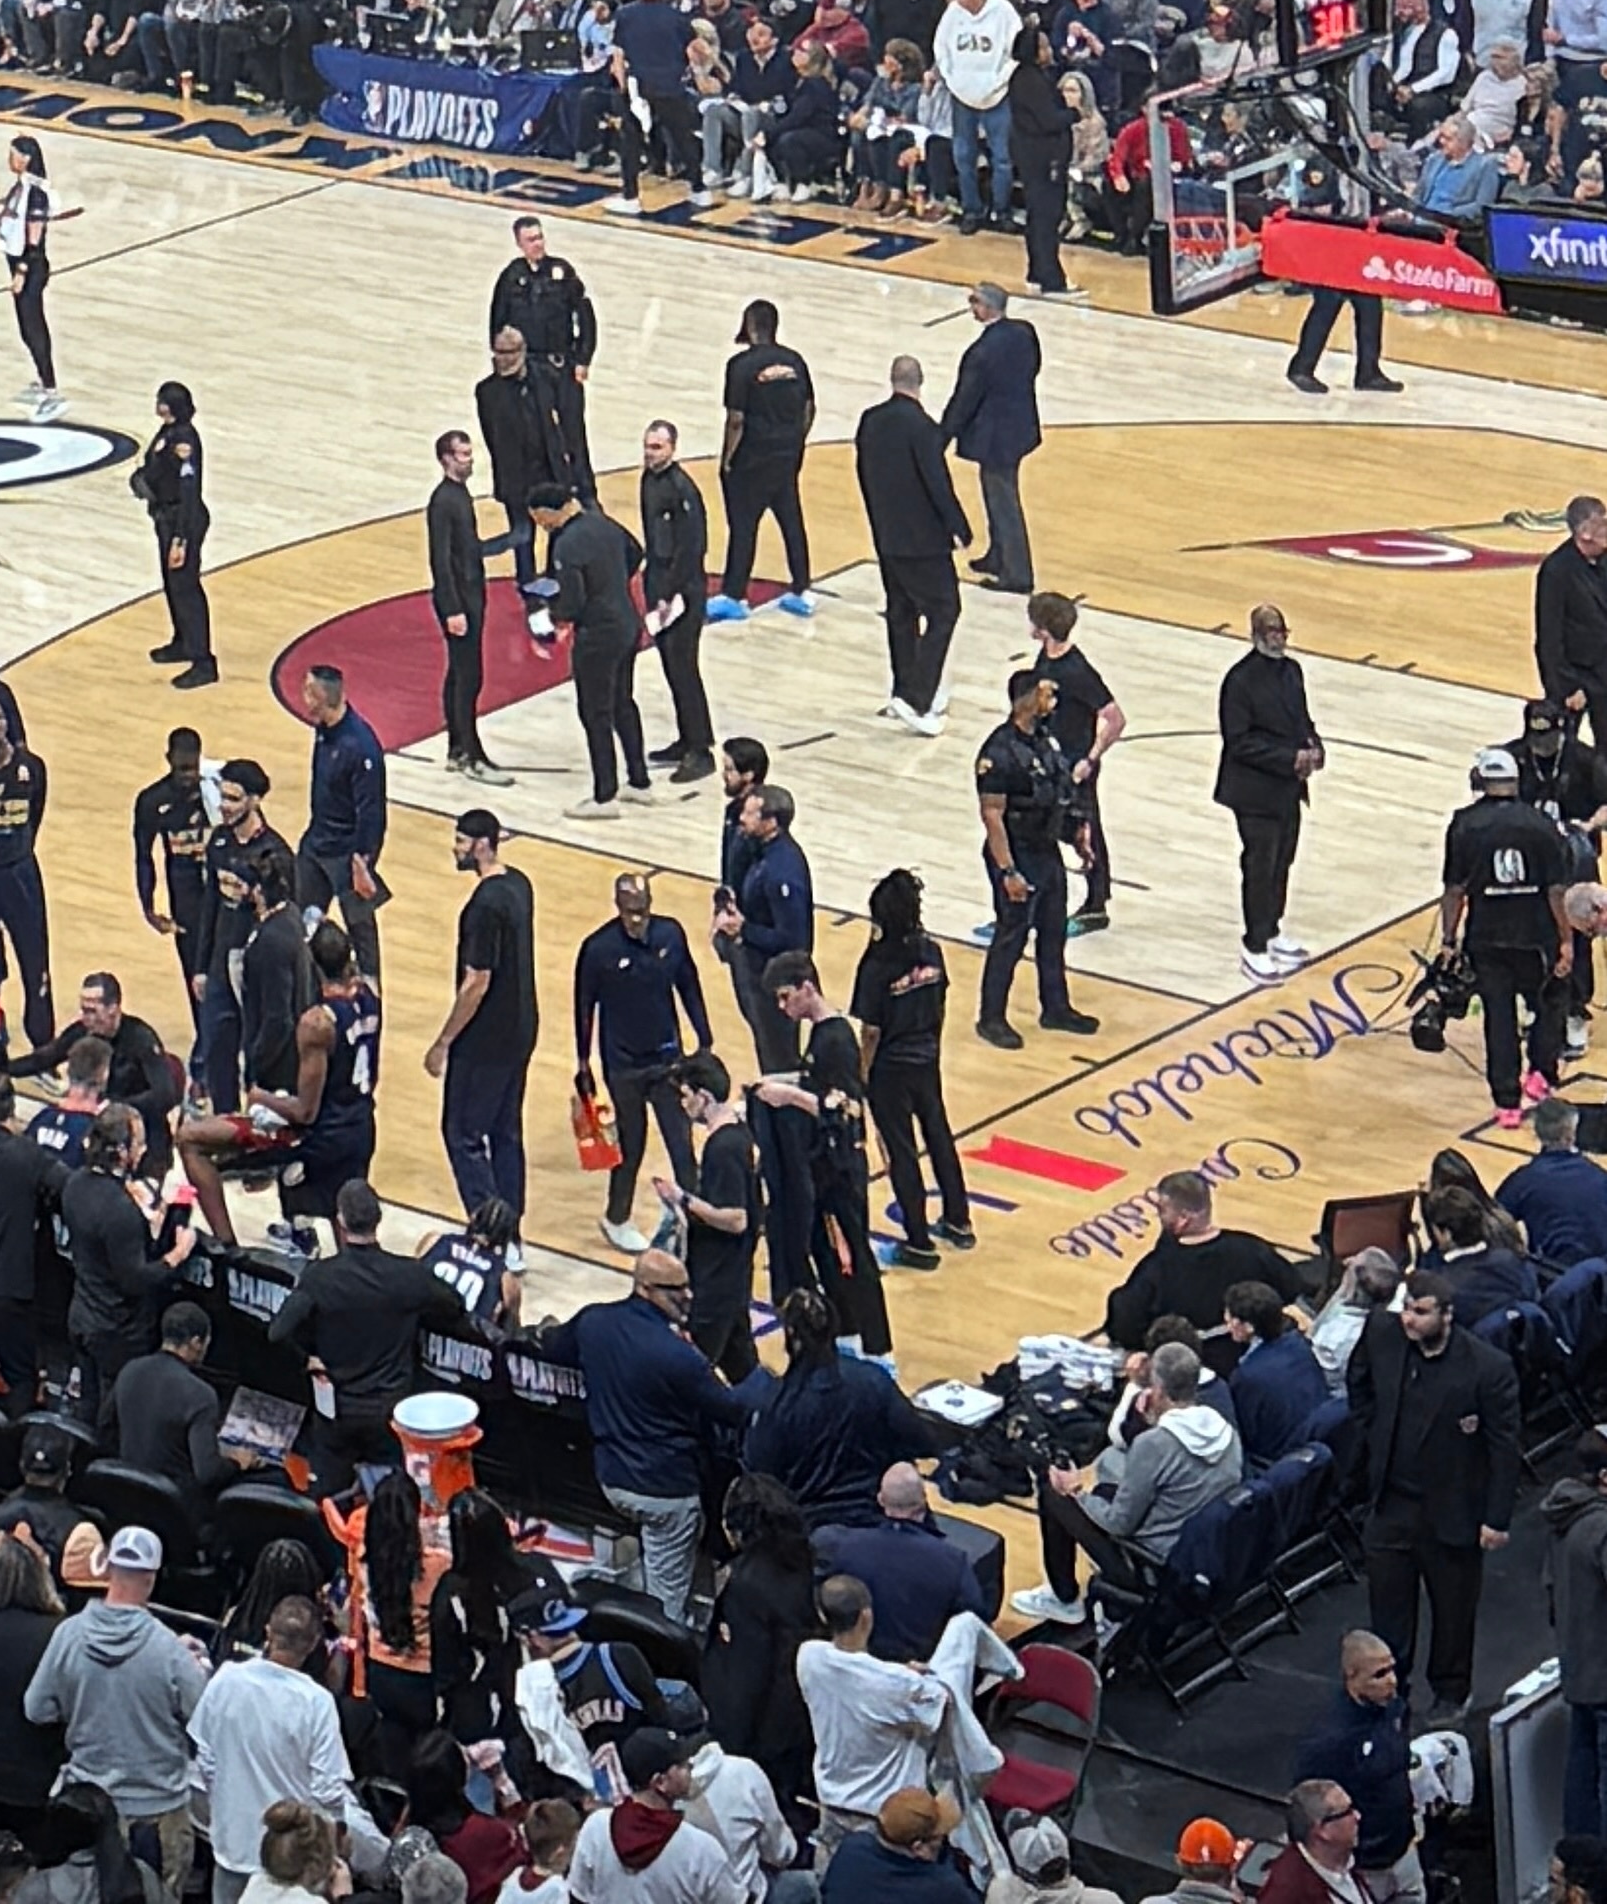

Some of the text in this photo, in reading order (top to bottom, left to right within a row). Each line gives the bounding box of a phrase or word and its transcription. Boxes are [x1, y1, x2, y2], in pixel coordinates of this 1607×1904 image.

[385, 82, 499, 149] PLAYOFFS
[1393, 258, 1496, 298] State Farm
